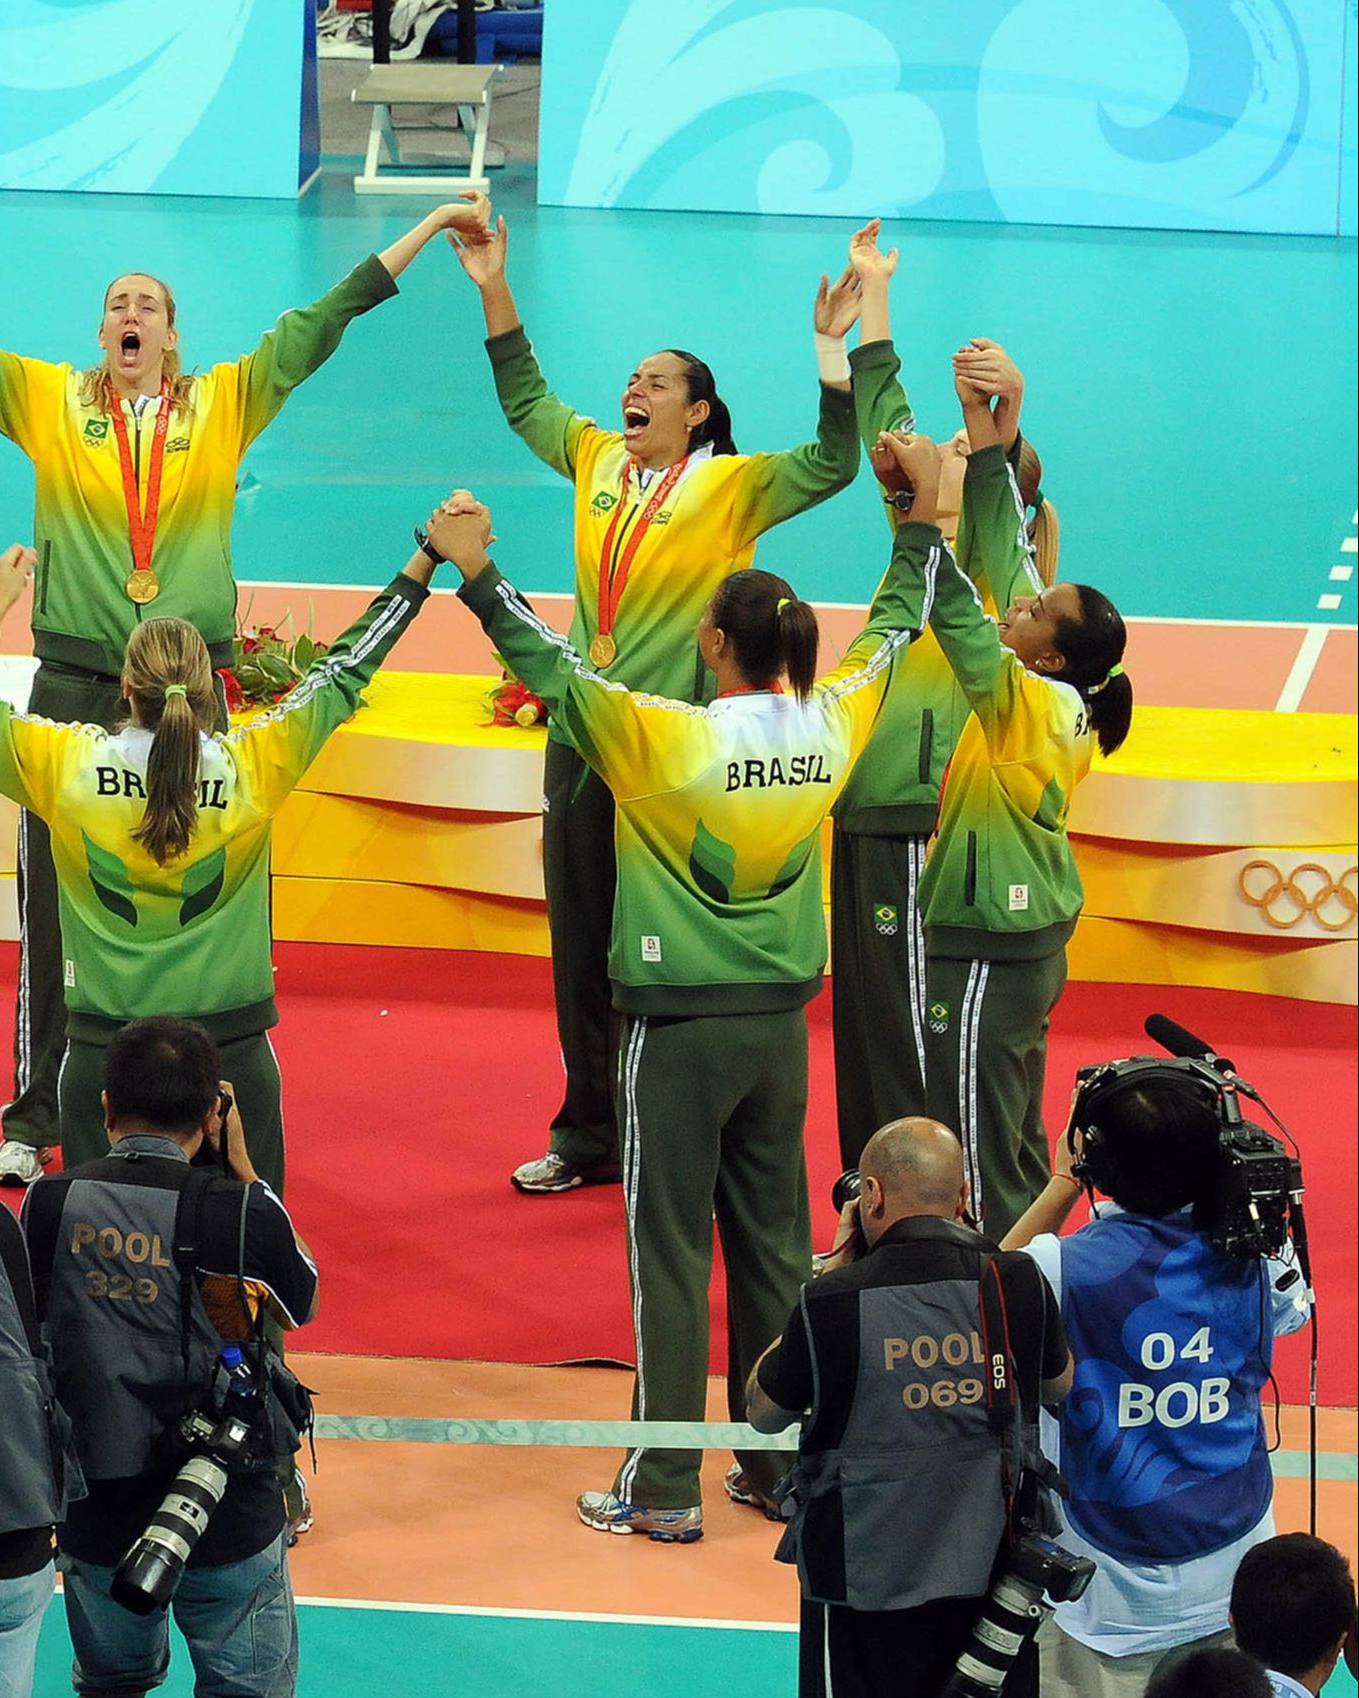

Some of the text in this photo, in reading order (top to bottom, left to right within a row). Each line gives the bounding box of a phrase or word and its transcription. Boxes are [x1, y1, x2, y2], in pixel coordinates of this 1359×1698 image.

[96, 766, 229, 811] BRIL
[725, 754, 832, 792] BRASIL
[70, 1222, 172, 1268] POOL
[84, 1269, 160, 1305] 329
[883, 1330, 986, 1371] POOL
[1140, 1326, 1215, 1371] 04
[991, 1353, 1007, 1390] EOS
[901, 1377, 985, 1410] 069
[1117, 1376, 1232, 1429] BOB
